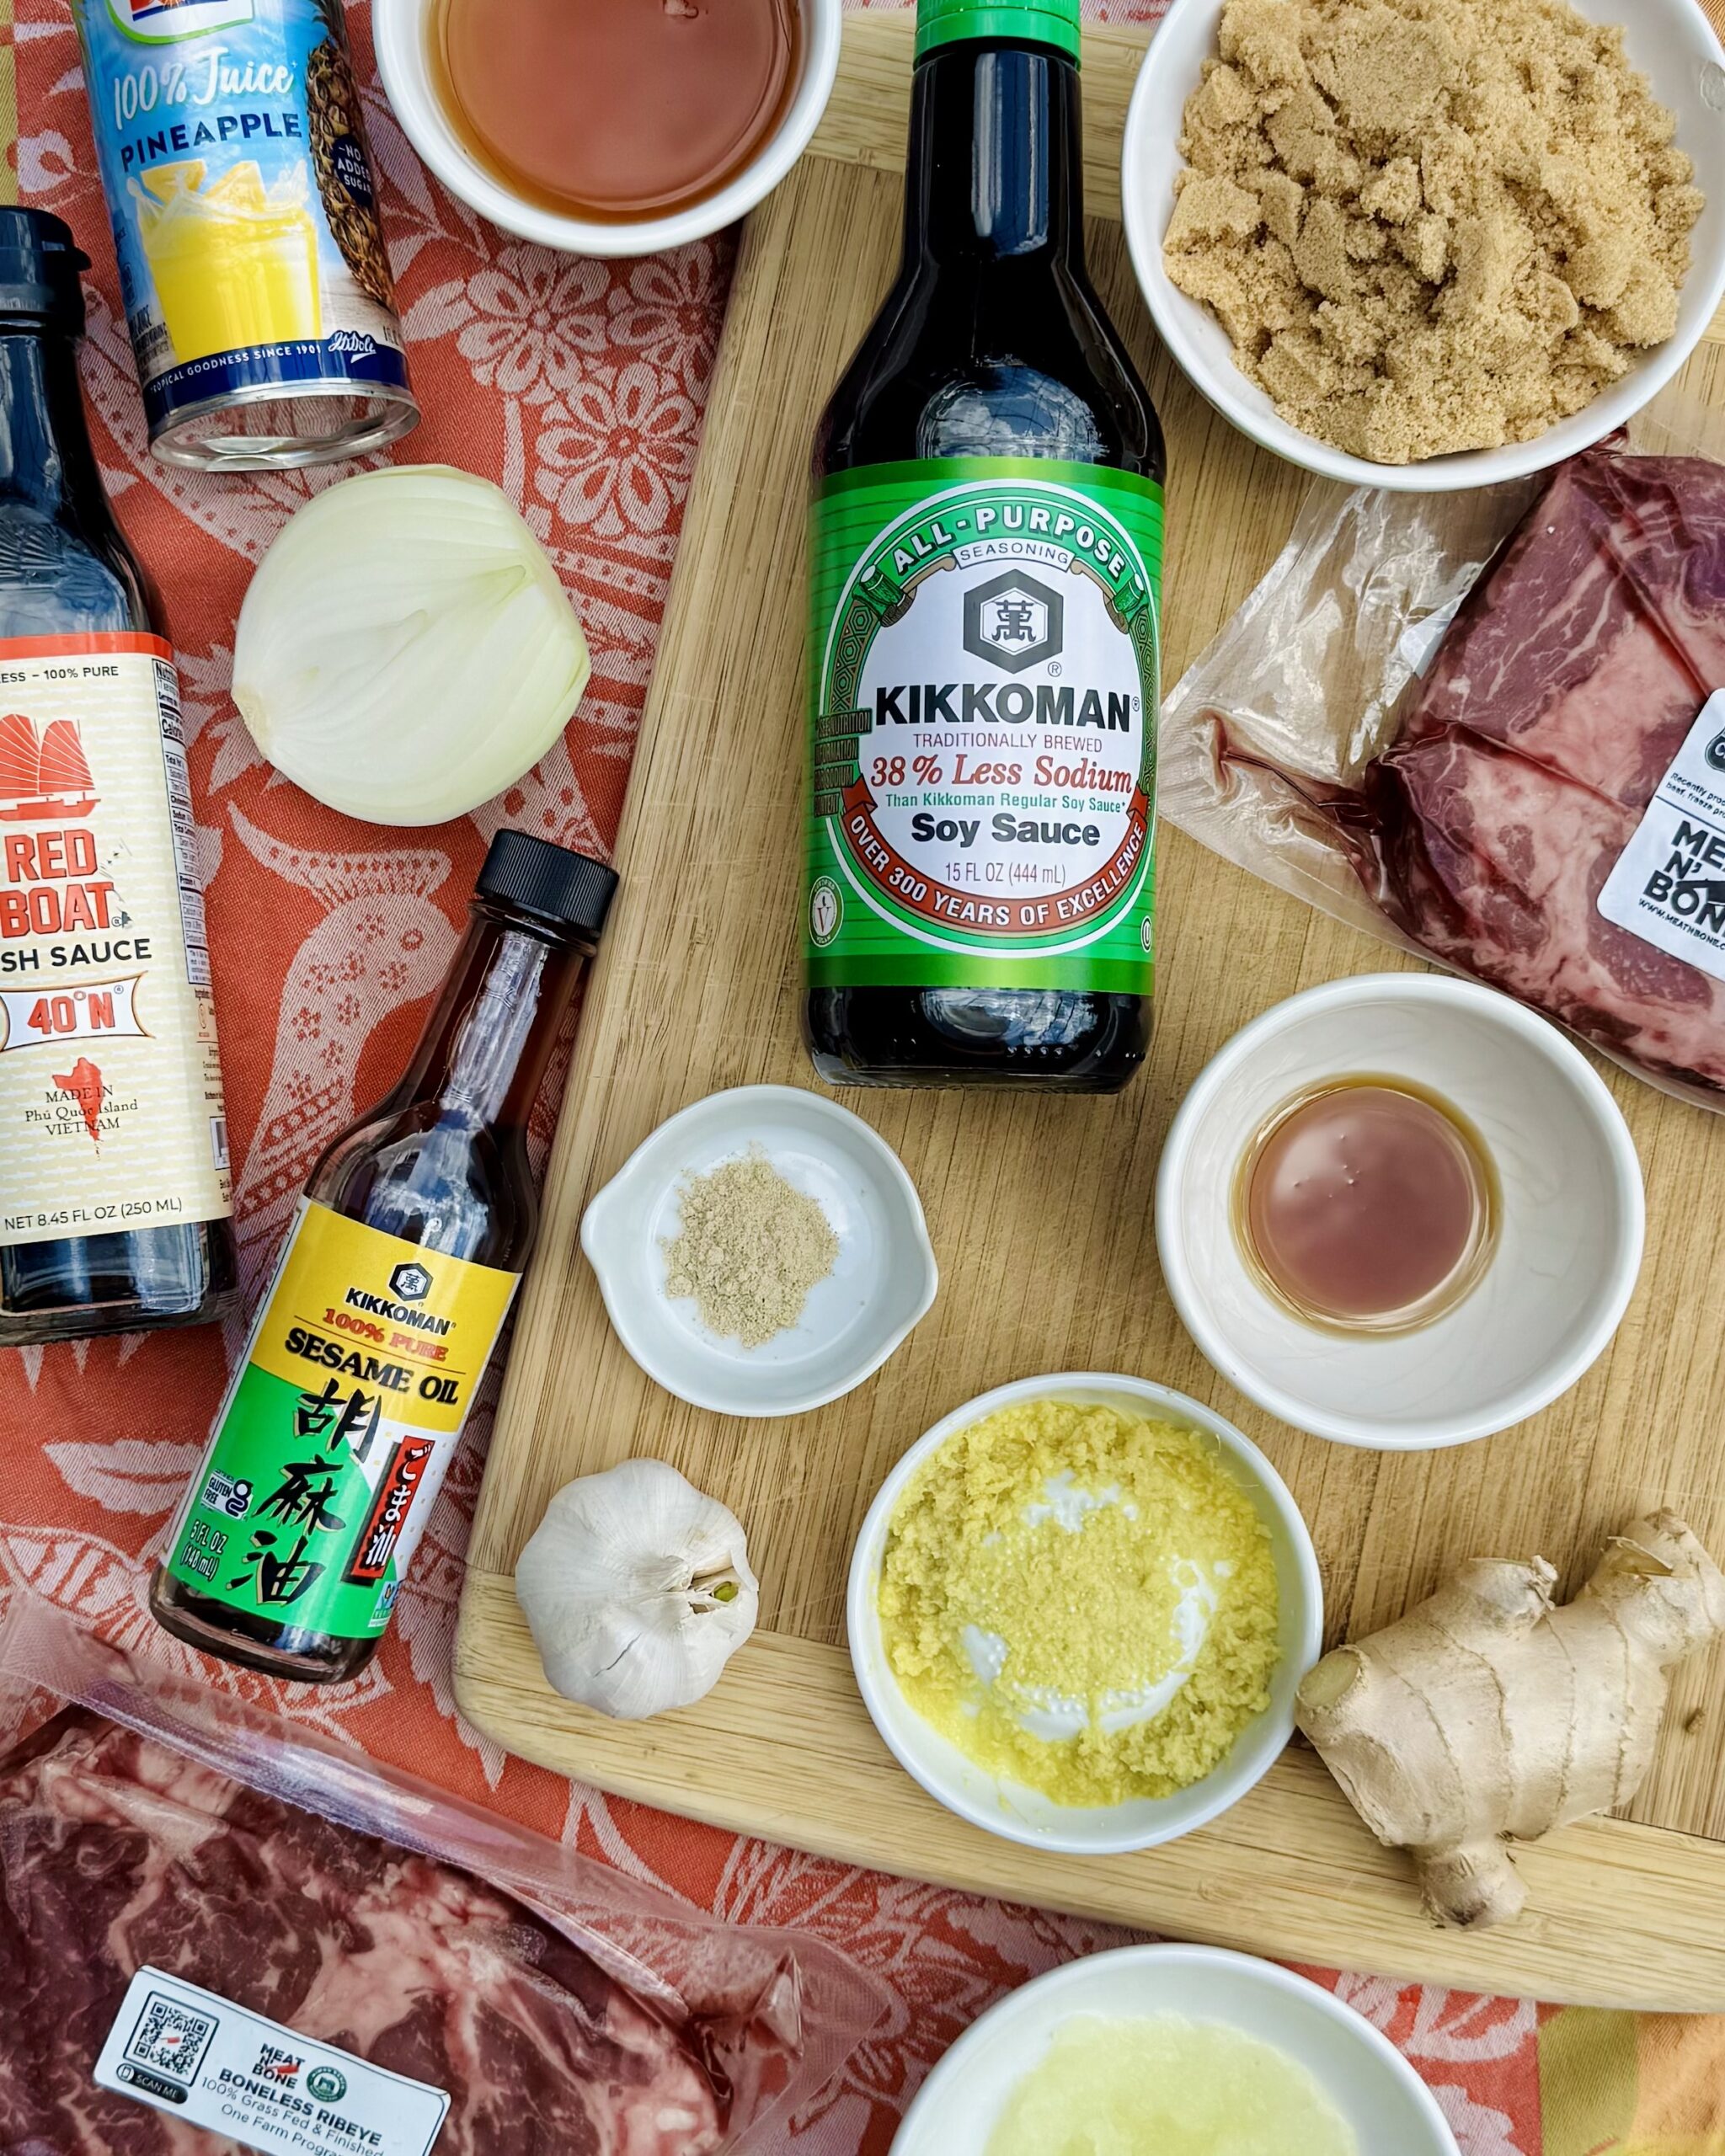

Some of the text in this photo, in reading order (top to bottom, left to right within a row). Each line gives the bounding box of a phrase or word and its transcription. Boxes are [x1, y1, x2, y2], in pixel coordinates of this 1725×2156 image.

[115, 46, 294, 130] 100% Juice
[120, 113, 302, 173] PINEAPPLE
[151, 370, 184, 393] TROPICAL
[187, 353, 249, 376] GOODNESS
[254, 346, 291, 360] SINCE
[296, 345, 321, 355] 1901
[893, 505, 1127, 578] ALL-PURPOSE
[960, 542, 1069, 564] SEASONING
[0, 671, 26, 684] ESS
[44, 668, 78, 680] 100%
[83, 666, 120, 677] PURE
[830, 712, 871, 734] NUTRITION
[876, 683, 1130, 733] KIKKOMAN
[914, 733, 1103, 753] TRADITIONALLY BREWED
[952, 754, 1023, 786] Less
[1034, 755, 1132, 793] Sodium
[1670, 772, 1707, 796] Recently
[885, 793, 918, 808] Than
[923, 792, 995, 806] Kikkoman
[1001, 793, 1057, 809] Regular
[1062, 795, 1085, 812] Soy
[1688, 792, 1713, 811] freeze
[911, 813, 1100, 848] Soy Sauce
[1671, 819, 1725, 872] ME
[4, 829, 99, 883] RED
[851, 815, 1144, 926] OVER 300 YEARS OF EXCELLENCE
[946, 862, 1065, 888] 15 FL OZ (444 mL)
[0, 881, 115, 938] BOAT
[1643, 869, 1725, 937] BON
[51, 938, 152, 967] SAUCE
[45, 1085, 114, 1103] MADE IN
[98, 1099, 138, 1114] Island
[45, 1117, 120, 1135] VIETNAM
[5, 1197, 183, 1230] NET 8.45 FL OZ (250 ML)
[345, 1287, 451, 1336] KIKKOMAN
[323, 1307, 449, 1362] 100% PURE
[284, 1326, 460, 1406] SESAME OIL
[204, 1487, 219, 1505] FREE
[208, 1476, 233, 1498] GLUTEN
[190, 1519, 228, 1554] 5 FL OZ
[181, 1543, 220, 1582] (148 mL)
[260, 2042, 306, 2067] MEAT
[136, 2074, 163, 2091] SCAN
[252, 2063, 298, 2089] BONE
[201, 2076, 384, 2156] 100% Grass Fed & Finished
[218, 2068, 314, 2116] BONELESS
[317, 2108, 382, 2147] RIBEYE
[222, 2103, 343, 2156] One Farm Progra
